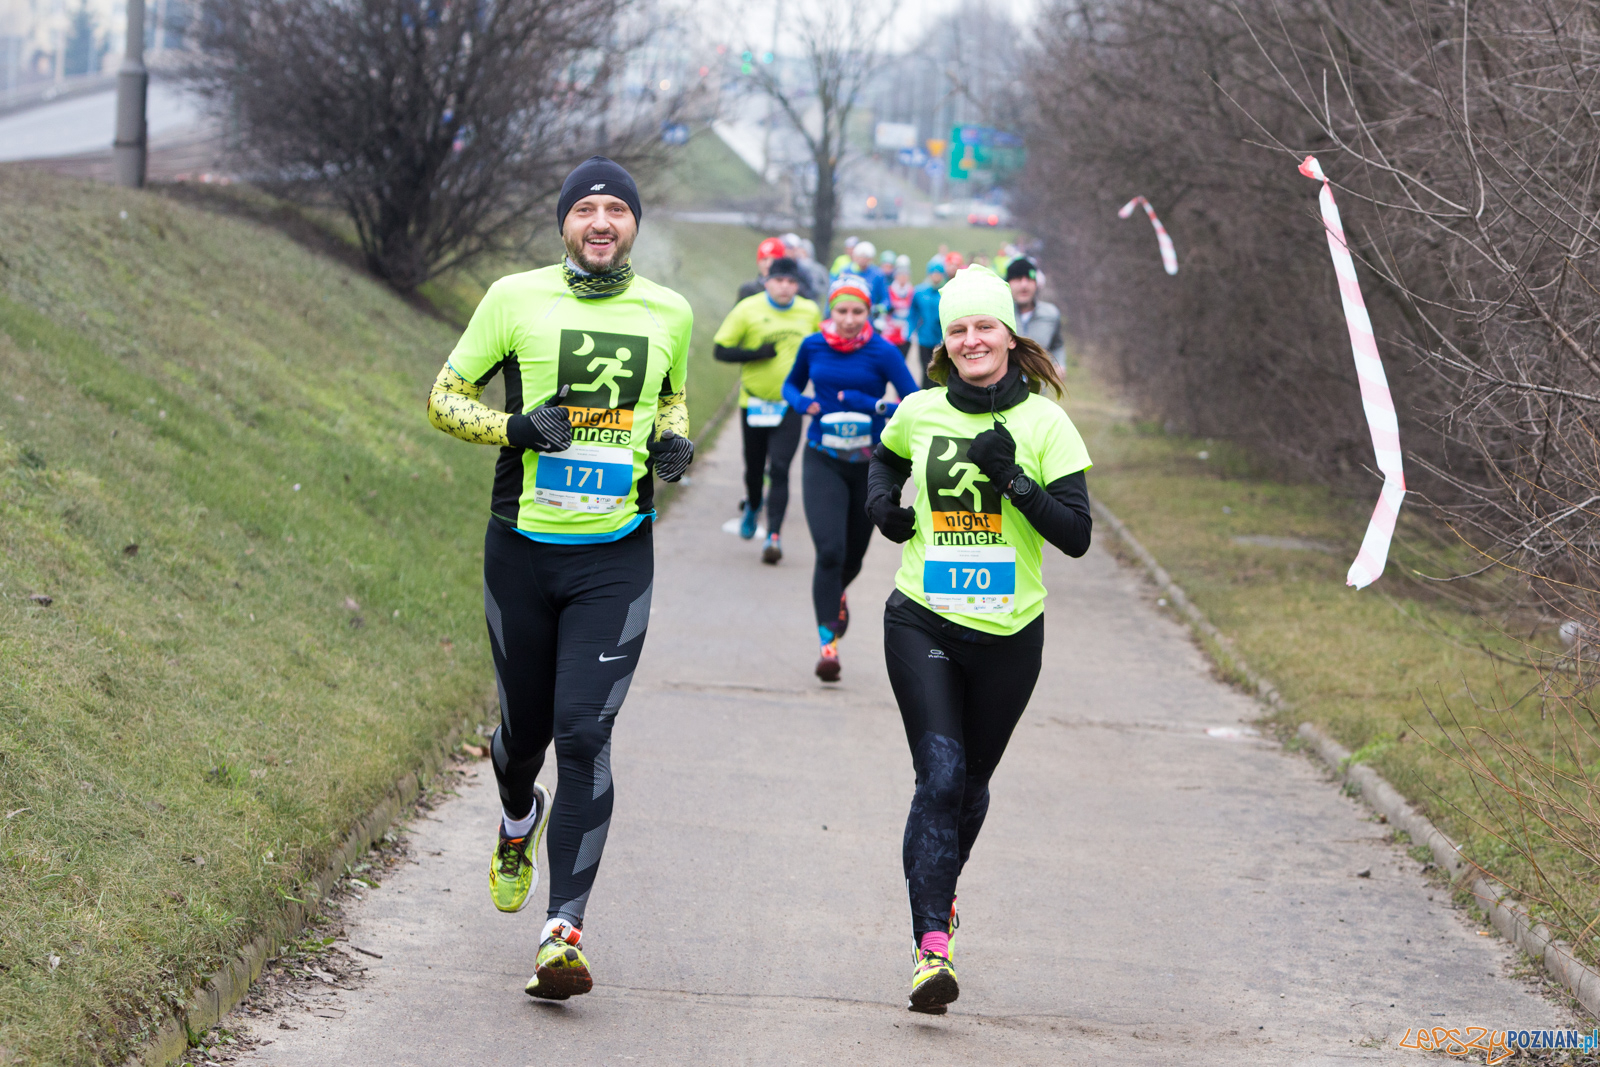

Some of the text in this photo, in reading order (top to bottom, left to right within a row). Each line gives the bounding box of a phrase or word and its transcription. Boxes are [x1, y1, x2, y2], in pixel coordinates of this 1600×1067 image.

[571, 408, 621, 427] night
[571, 427, 631, 445] nners
[833, 423, 858, 437] 152
[564, 465, 604, 490] 171
[945, 511, 991, 531] night
[934, 531, 1007, 546] runners
[948, 567, 991, 590] 170
